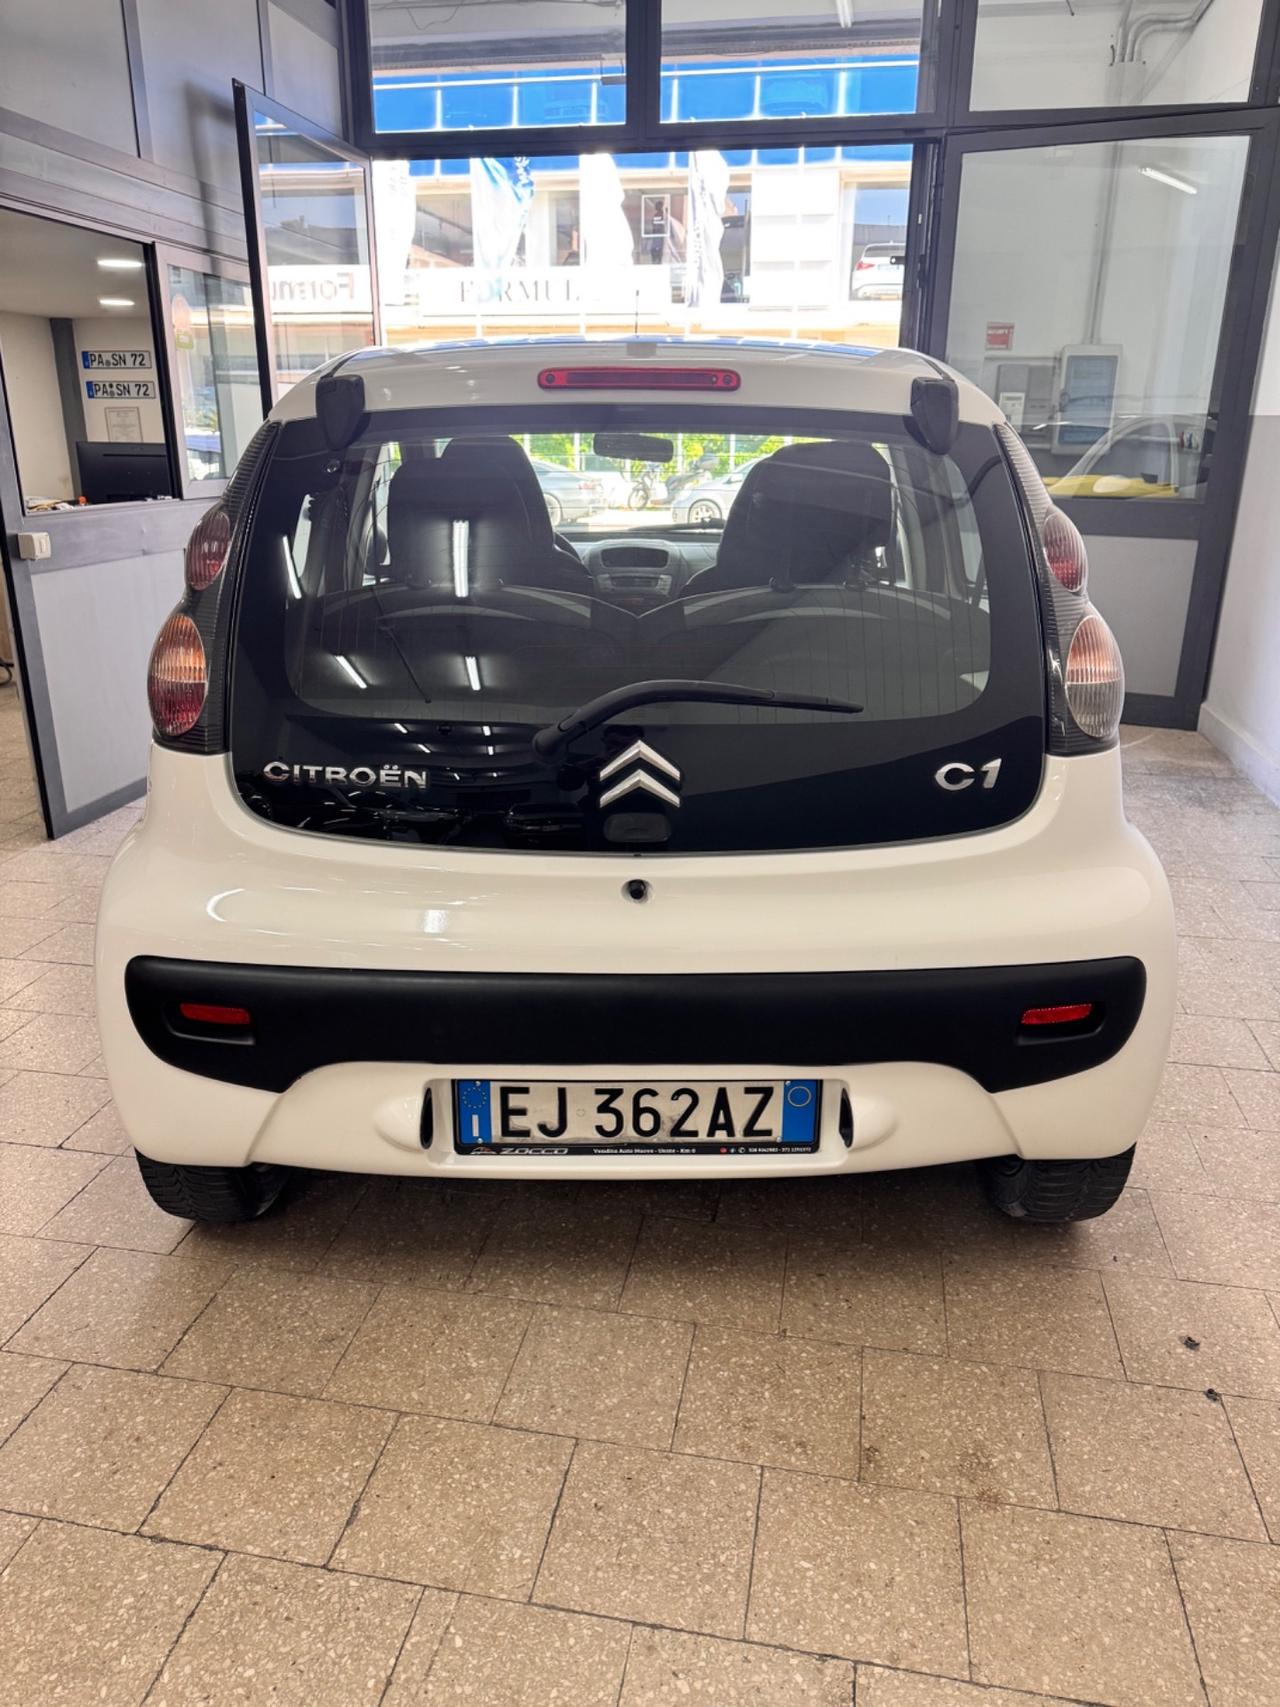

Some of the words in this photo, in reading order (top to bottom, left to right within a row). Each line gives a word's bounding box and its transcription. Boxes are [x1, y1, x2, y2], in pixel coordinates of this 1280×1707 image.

[89, 353, 105, 367] PA
[111, 353, 127, 367] SN
[130, 353, 146, 366] 72
[93, 383, 109, 396] PA
[115, 383, 131, 397] SN
[134, 383, 150, 397] 72
[263, 761, 427, 788] CITROËN
[935, 758, 1002, 791] C1
[500, 1086, 567, 1138] EJ
[593, 1086, 775, 1138] 362AZ
[500, 1147, 569, 1155] ZOCCO
